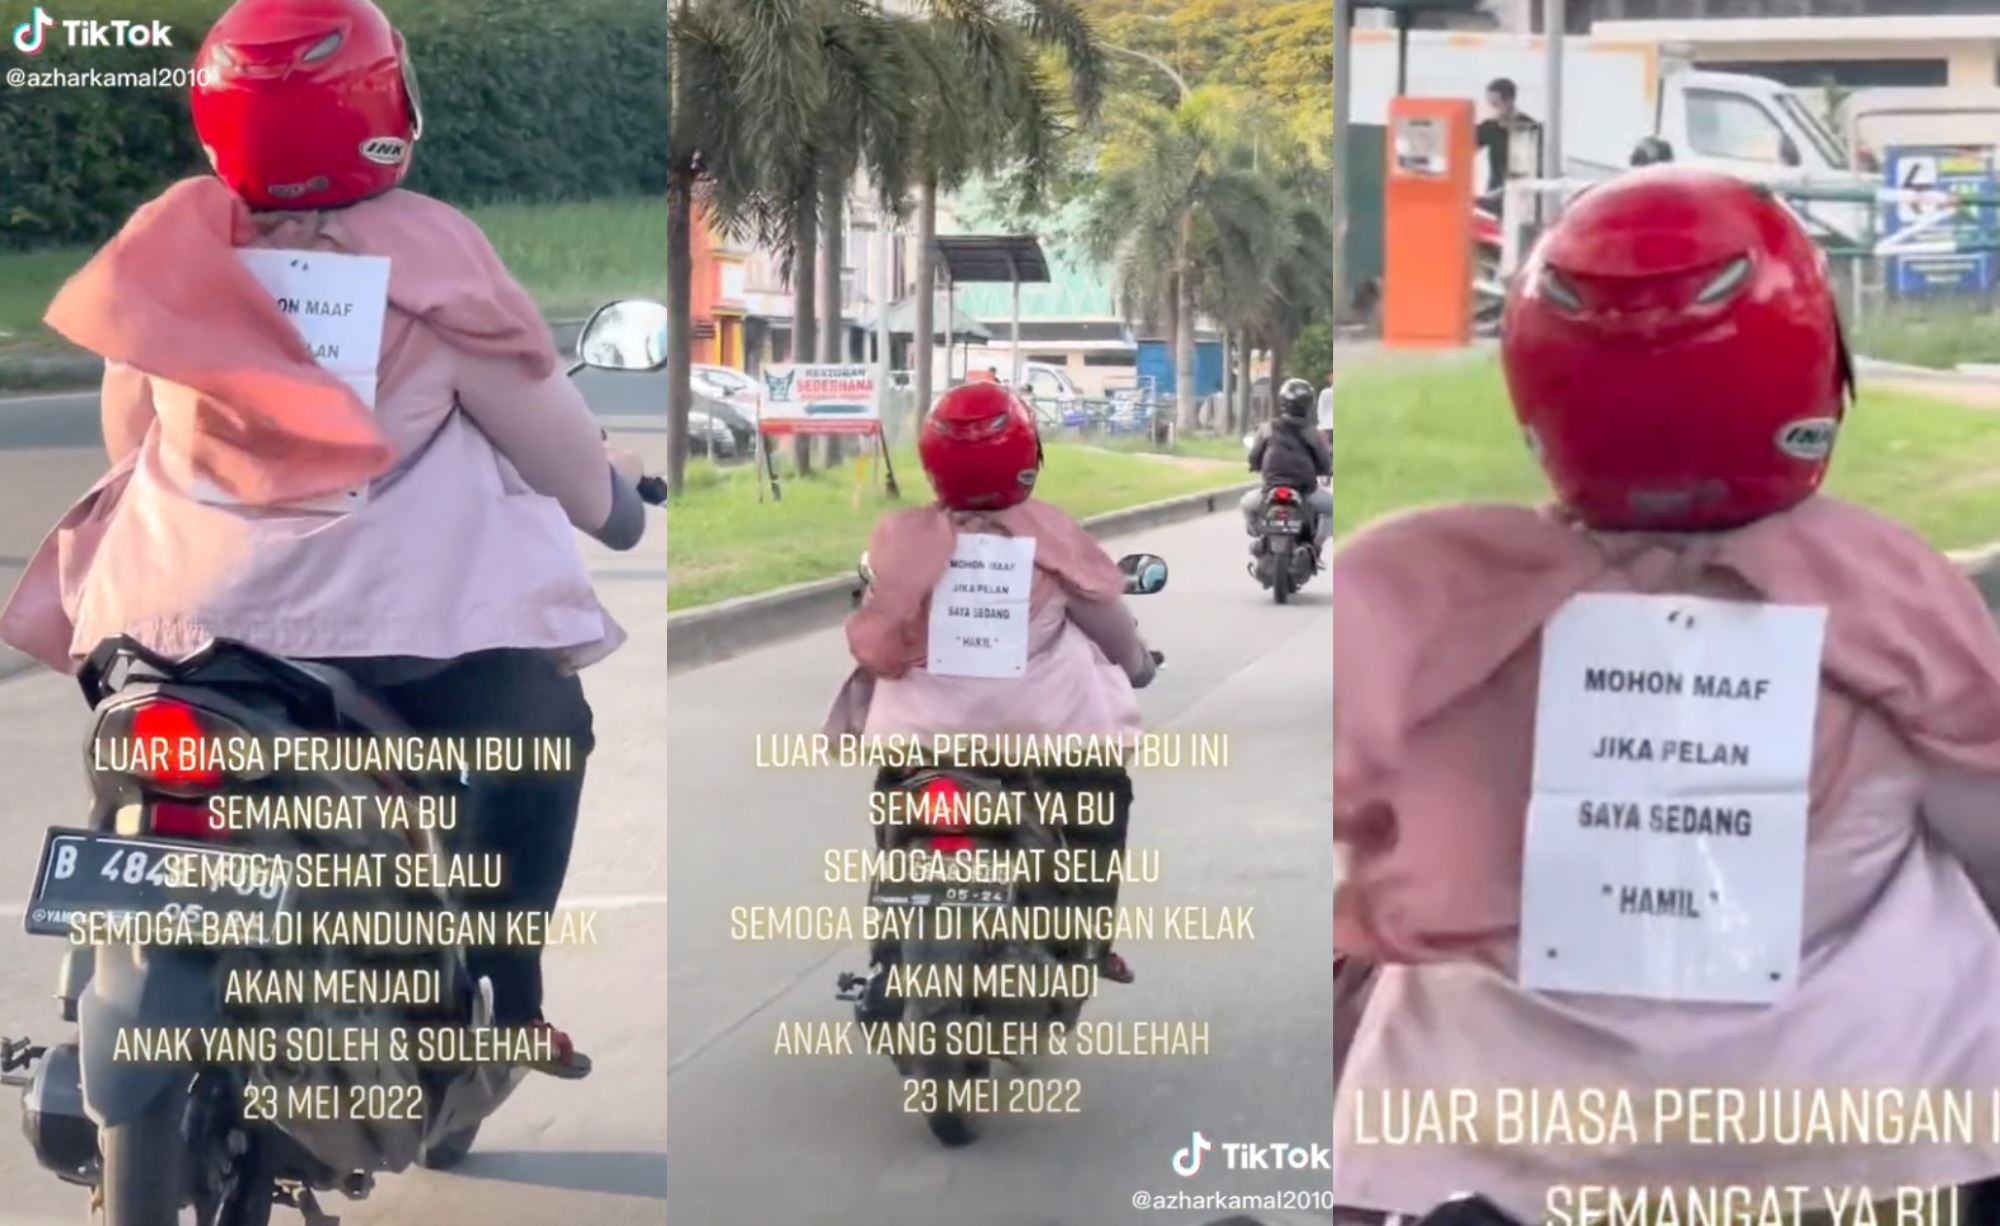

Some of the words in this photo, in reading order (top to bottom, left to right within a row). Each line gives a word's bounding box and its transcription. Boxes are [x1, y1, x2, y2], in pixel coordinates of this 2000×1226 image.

[305, 300, 353, 316] MAAF
[953, 583, 976, 592] JIKA
[973, 607, 1010, 619] SEDANG
[1584, 668, 1683, 695] MOHON
[1693, 675, 1769, 701] MAAF
[1593, 737, 1654, 761] JIKA
[1661, 740, 1750, 766] PELAN
[1579, 801, 1641, 830] SAYA
[1650, 804, 1753, 837] SEDANG
[54, 845, 78, 879] B
[1619, 885, 1700, 919] HAMIL
